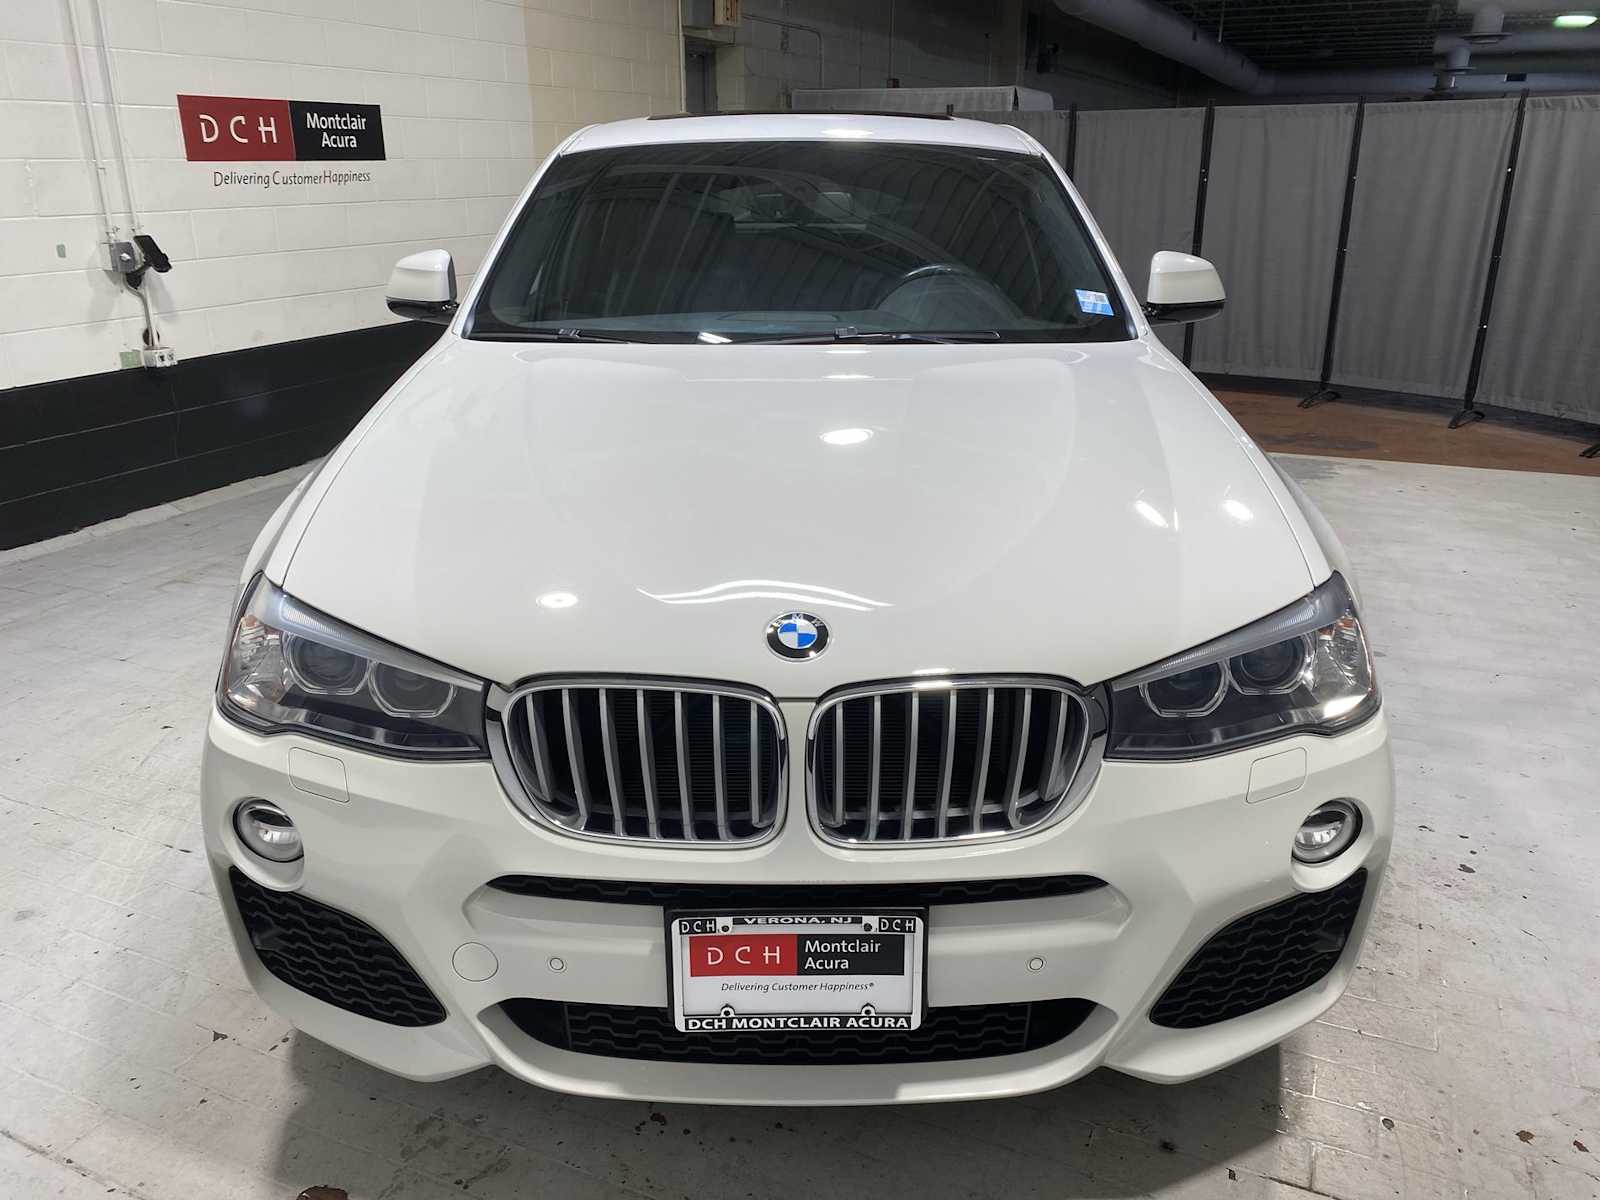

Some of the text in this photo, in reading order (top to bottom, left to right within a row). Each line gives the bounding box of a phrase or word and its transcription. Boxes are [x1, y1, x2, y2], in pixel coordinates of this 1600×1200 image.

[306, 112, 367, 130] Montclair
[199, 114, 278, 143] DCH
[321, 132, 358, 148] Acura
[213, 170, 371, 188] Delivering Customer Happiness
[680, 920, 715, 933] DCH
[744, 916, 852, 925] VERONA, NJ
[880, 918, 915, 931] DCH
[804, 940, 881, 953] Montclair
[707, 946, 780, 966] DCH
[804, 957, 849, 970] Acura
[721, 982, 769, 992] Delivering
[772, 982, 818, 991] Customer
[688, 1017, 909, 1030] DCH MONTCLAIR ACURA
